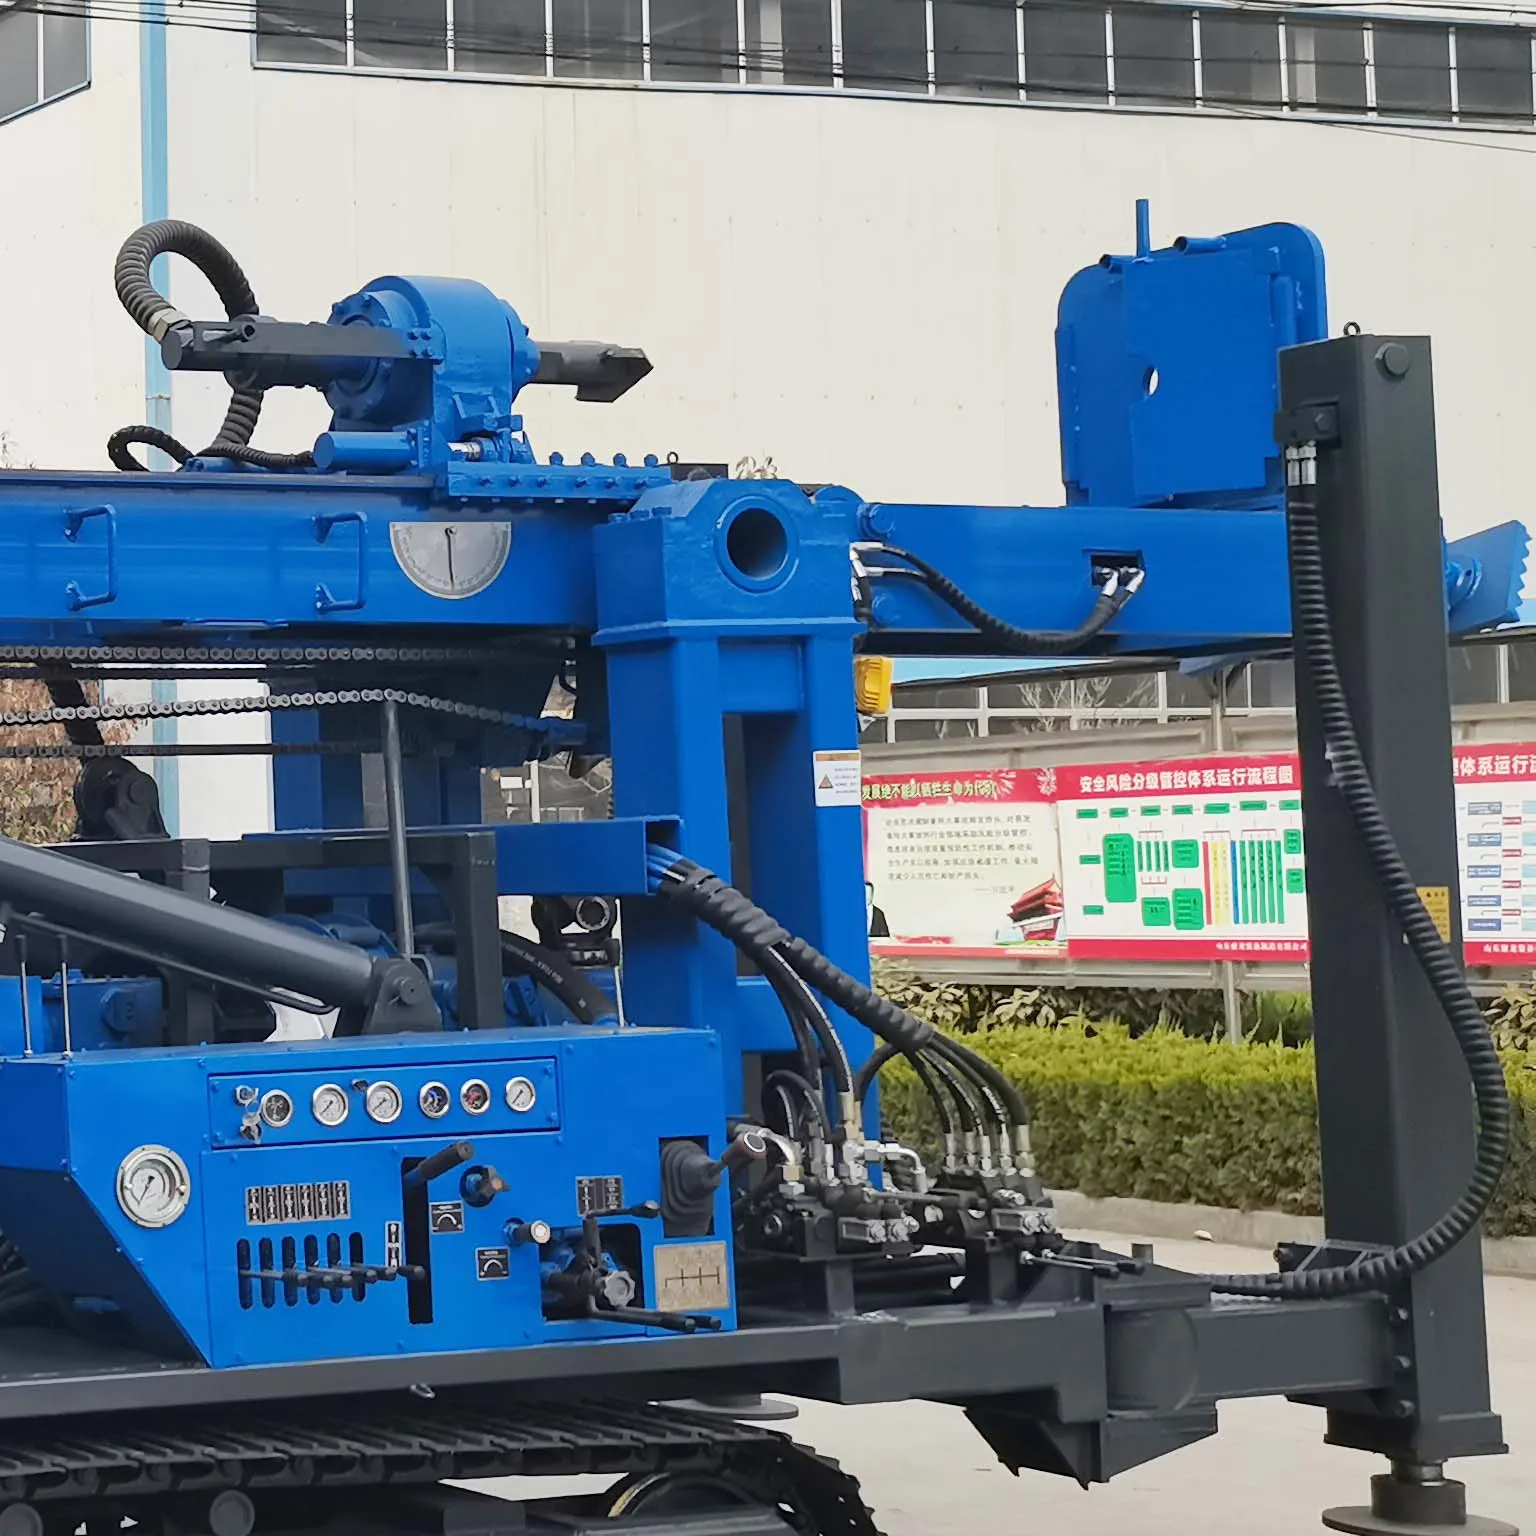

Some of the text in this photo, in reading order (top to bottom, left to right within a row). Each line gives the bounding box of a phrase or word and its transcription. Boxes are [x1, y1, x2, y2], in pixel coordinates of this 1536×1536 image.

[1079, 765, 1293, 793] 安全风险分级管控体系运行流程图
